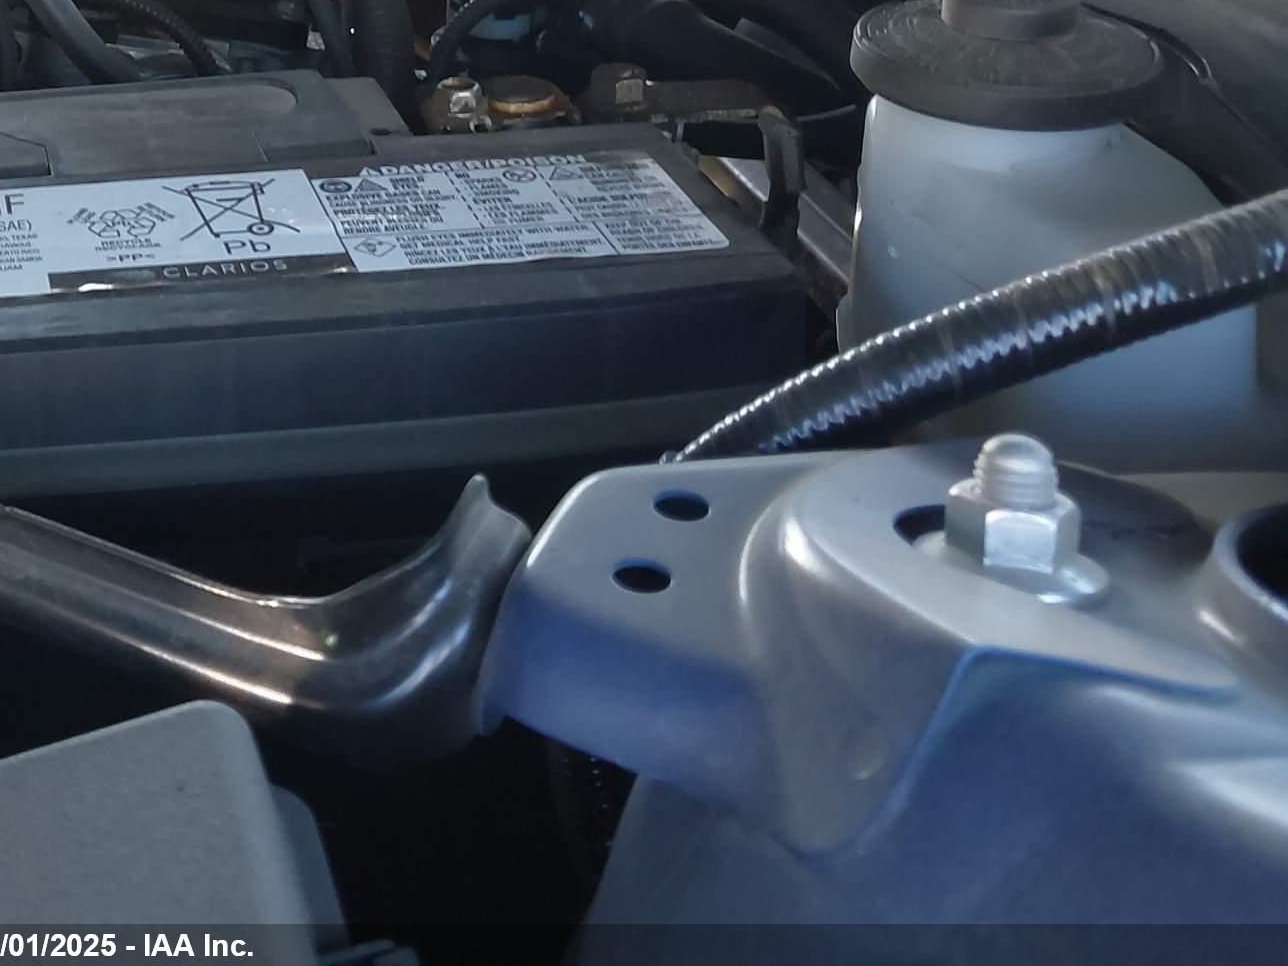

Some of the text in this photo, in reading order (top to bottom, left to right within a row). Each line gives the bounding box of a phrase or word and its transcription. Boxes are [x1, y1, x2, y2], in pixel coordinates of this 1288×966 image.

[379, 154, 586, 175] DANGER/POISON
[224, 240, 271, 255] Pb
[163, 260, 288, 279] CLARIOS
